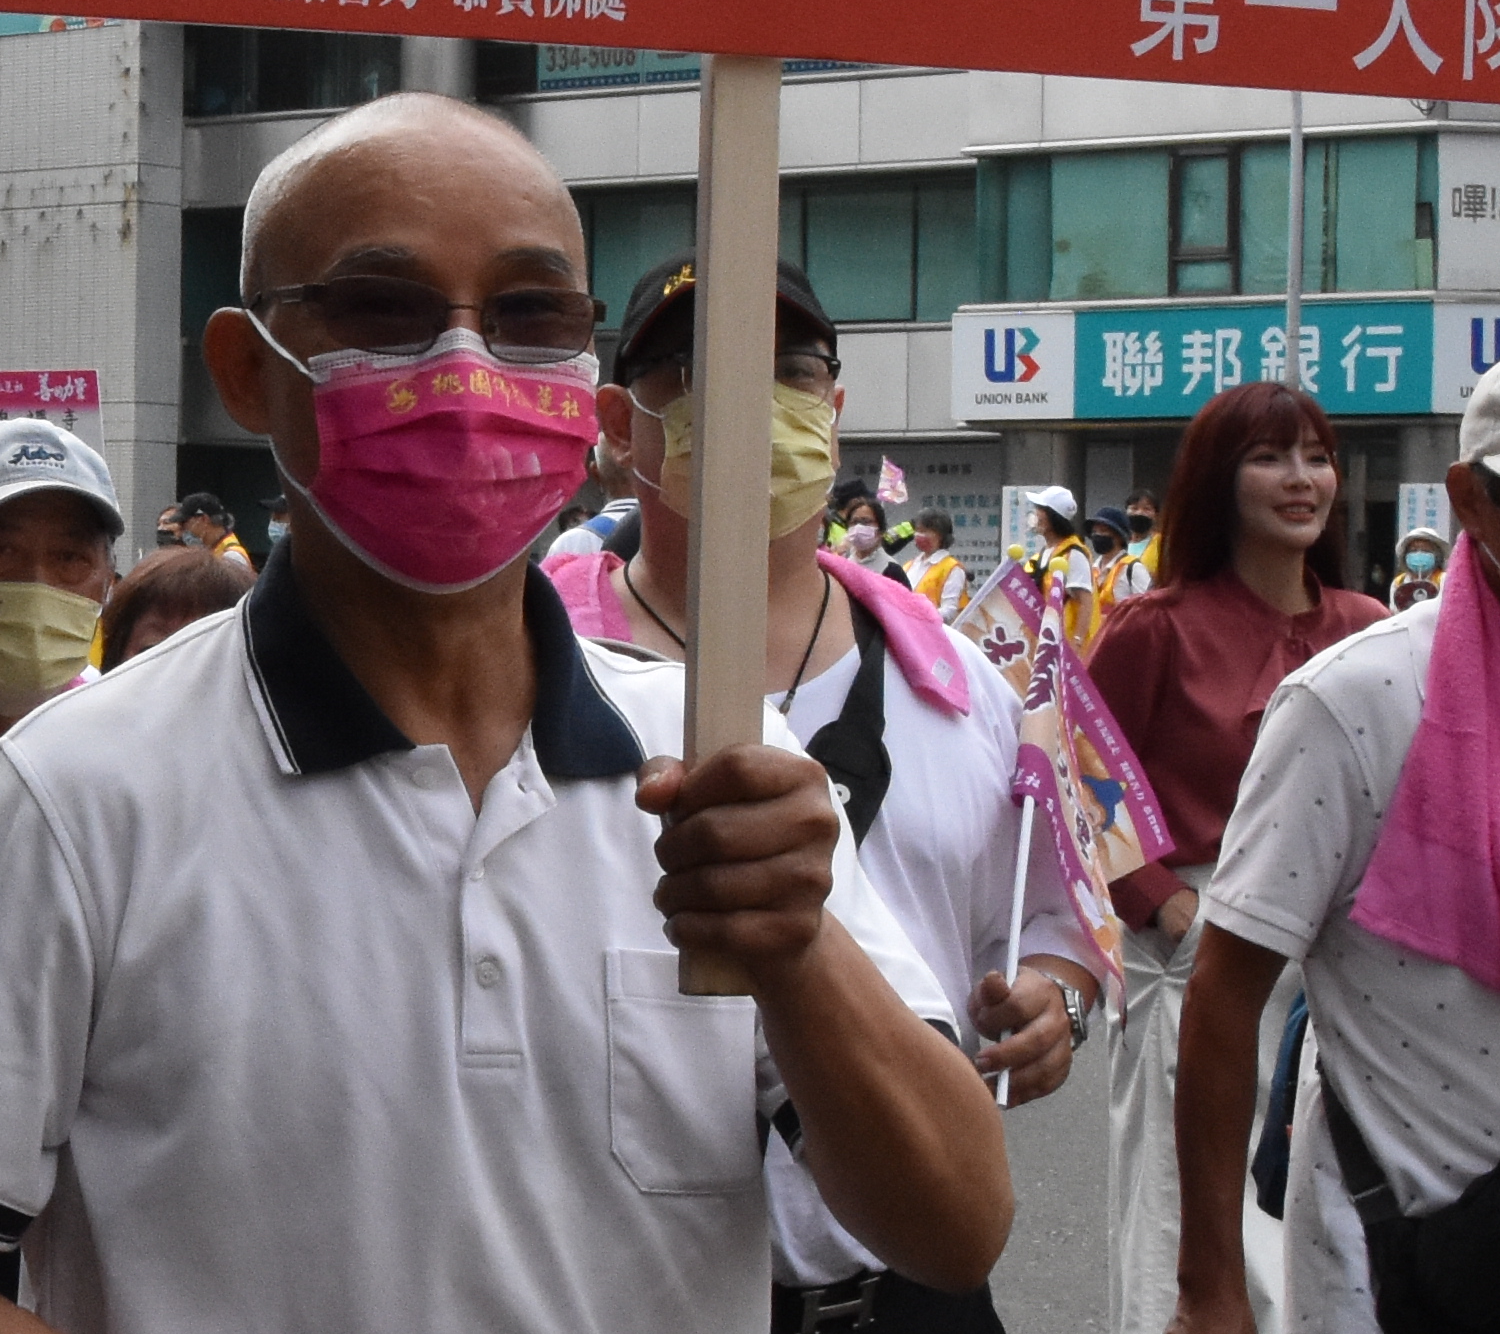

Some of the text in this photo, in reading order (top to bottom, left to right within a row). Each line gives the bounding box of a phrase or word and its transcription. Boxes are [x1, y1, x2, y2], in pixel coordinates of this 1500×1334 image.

[1102, 324, 1404, 397] 聯邦銀行
[975, 392, 1048, 405] UNION BANK
